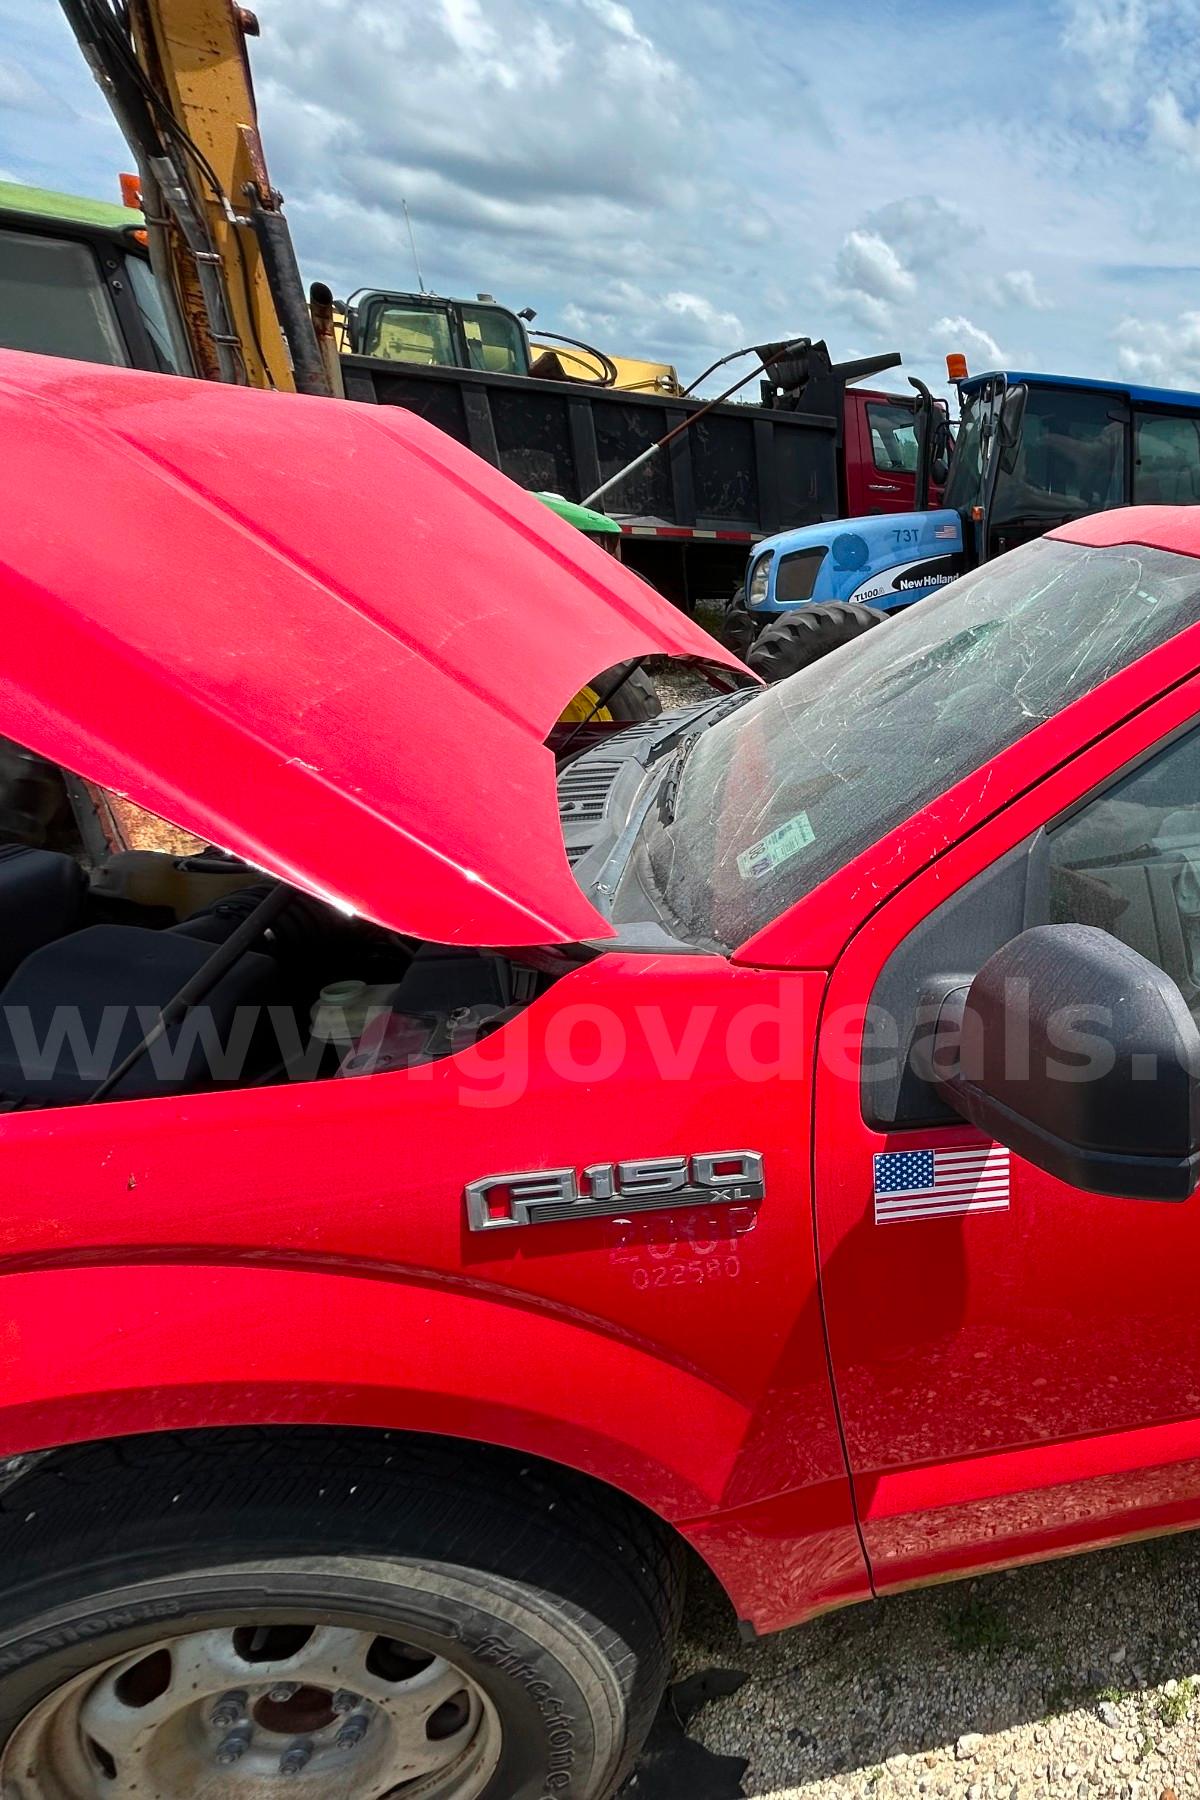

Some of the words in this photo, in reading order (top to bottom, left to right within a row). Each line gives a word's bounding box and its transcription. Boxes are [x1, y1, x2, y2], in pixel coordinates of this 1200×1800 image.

[891, 528, 920, 543] 73T
[899, 578, 924, 591] New
[710, 1188, 751, 1203] XL
[471, 1634, 576, 1792] Firestone
